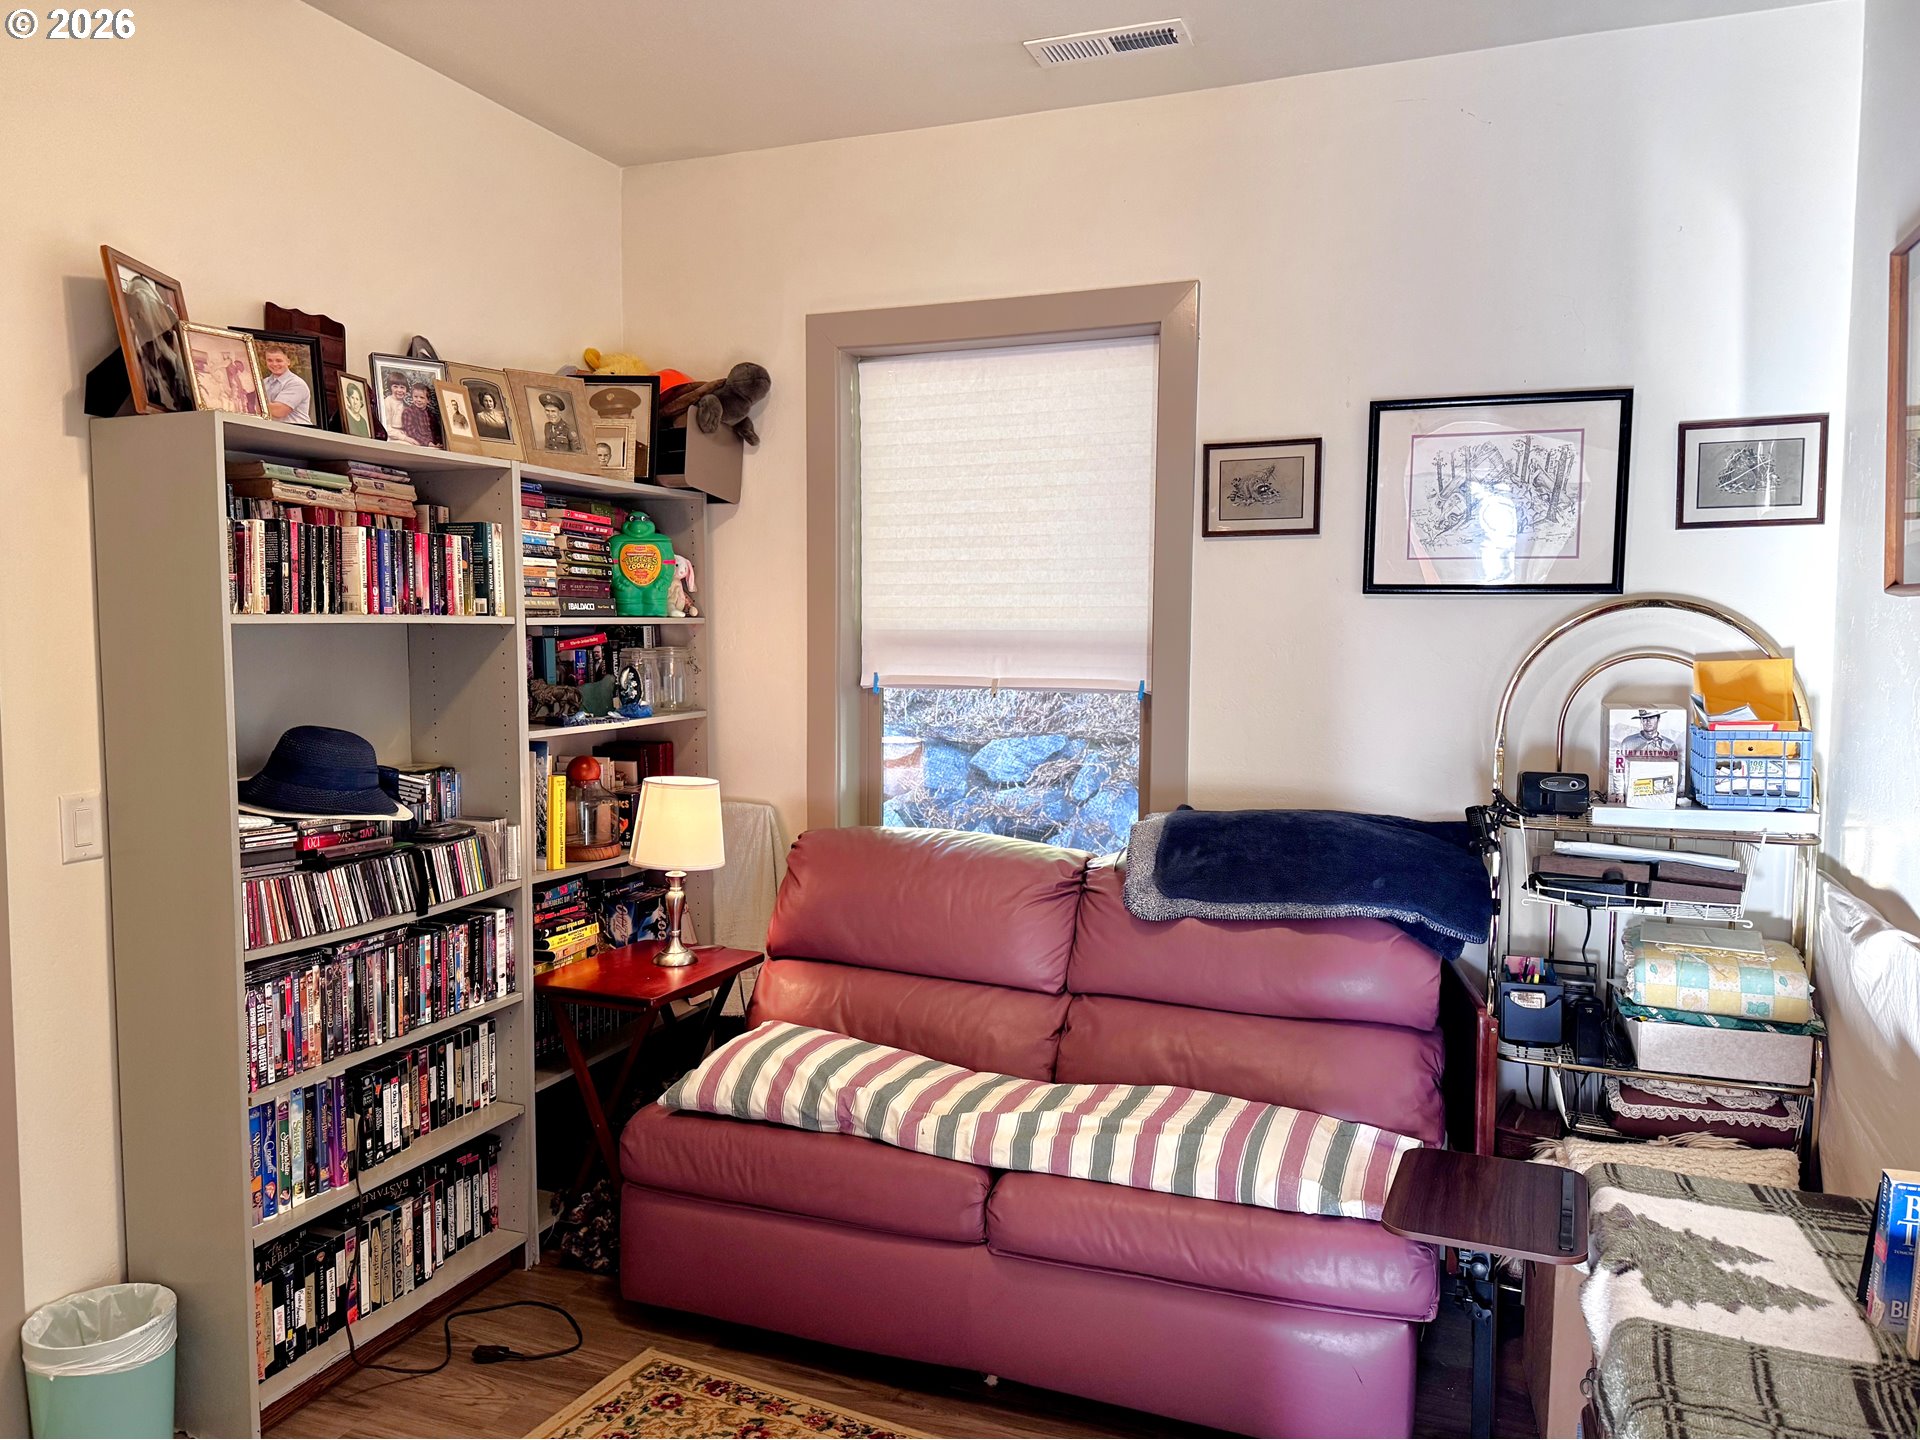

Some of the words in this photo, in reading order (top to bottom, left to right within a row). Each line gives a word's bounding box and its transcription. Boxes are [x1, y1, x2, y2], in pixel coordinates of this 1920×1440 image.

[628, 562, 655, 571] COOKIES
[307, 836, 321, 851] 120
[360, 826, 376, 838] JVC
[257, 1003, 266, 1026] STEVE
[258, 1037, 267, 1072] McQUEEN
[280, 1131, 290, 1153] Snow
[292, 1120, 303, 1158] SHREK
[265, 1140, 276, 1173] Cinderella
[283, 1154, 291, 1175] White
[361, 1178, 410, 1205] BASTARD
[264, 1238, 300, 1271] REBELS
